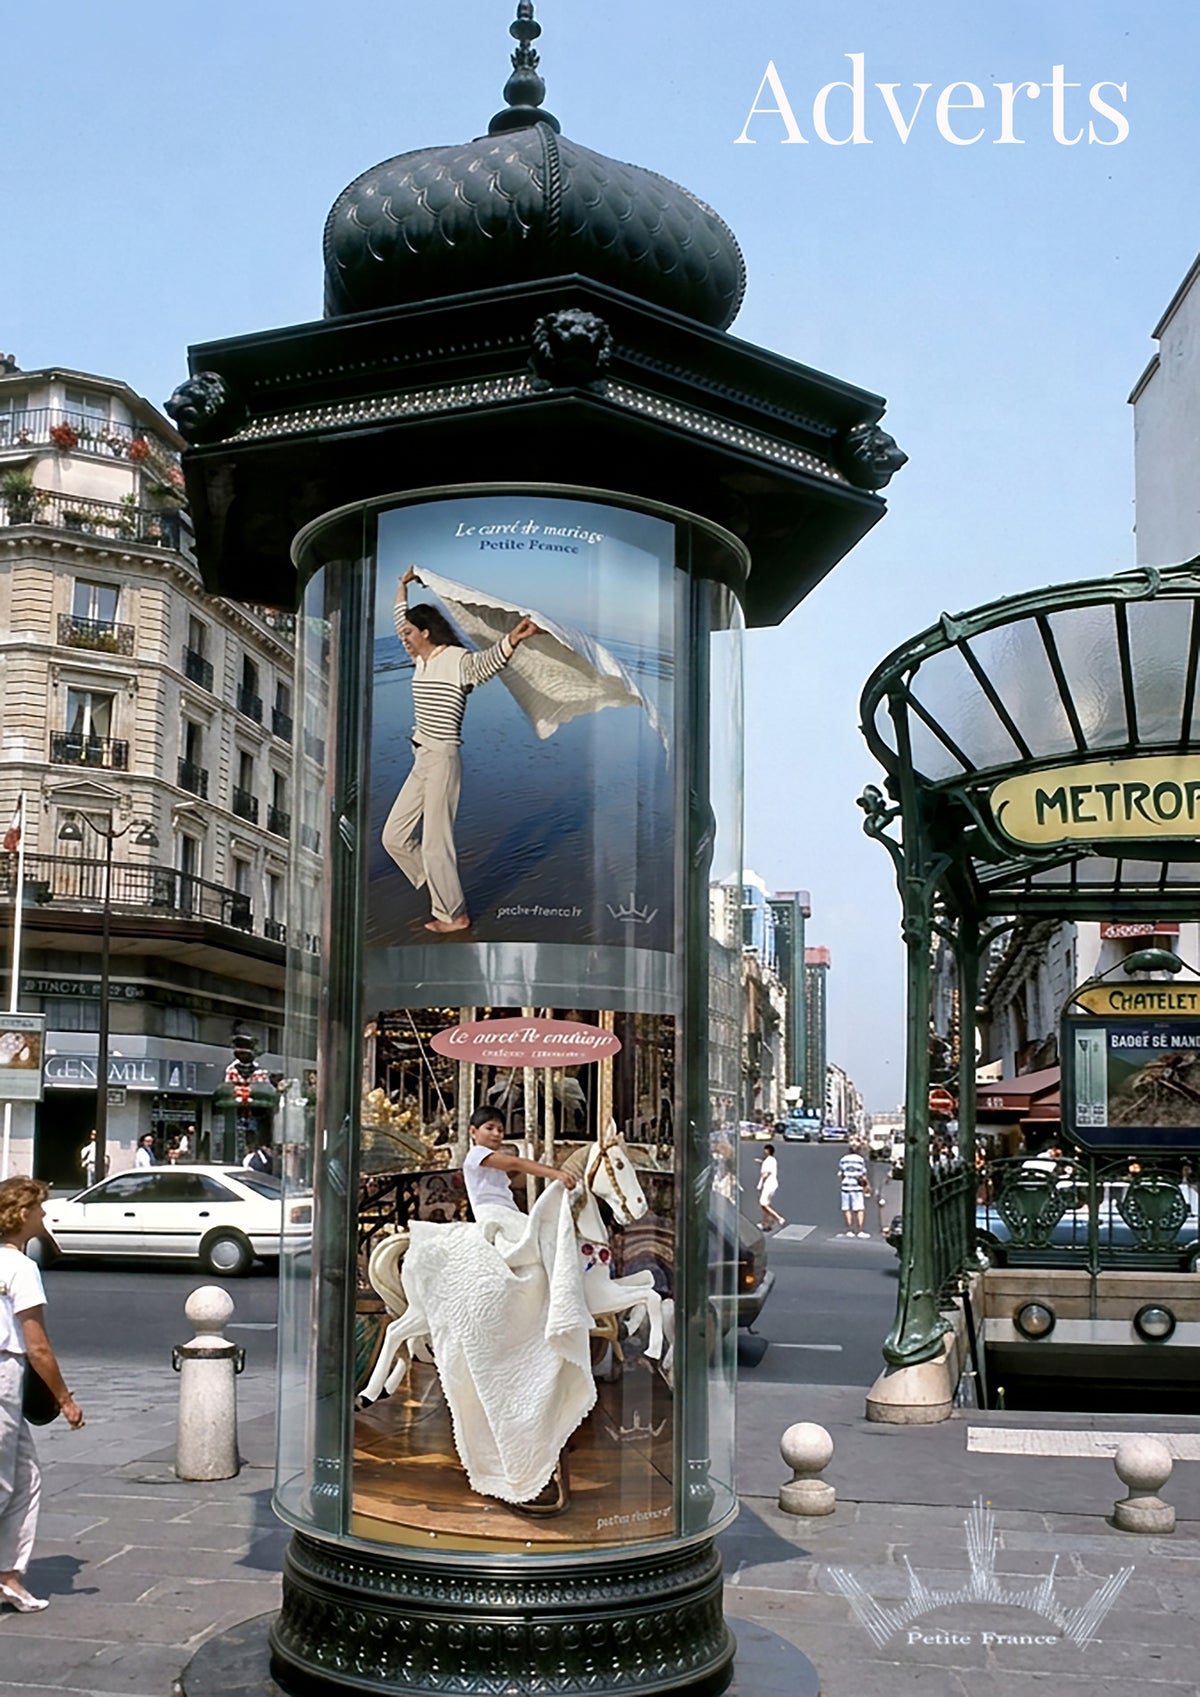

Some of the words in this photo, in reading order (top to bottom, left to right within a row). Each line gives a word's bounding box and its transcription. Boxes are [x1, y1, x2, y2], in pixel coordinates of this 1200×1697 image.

[455, 522, 477, 538] Le
[480, 538, 525, 551] Petite
[1109, 990, 1198, 1011] CHATELET
